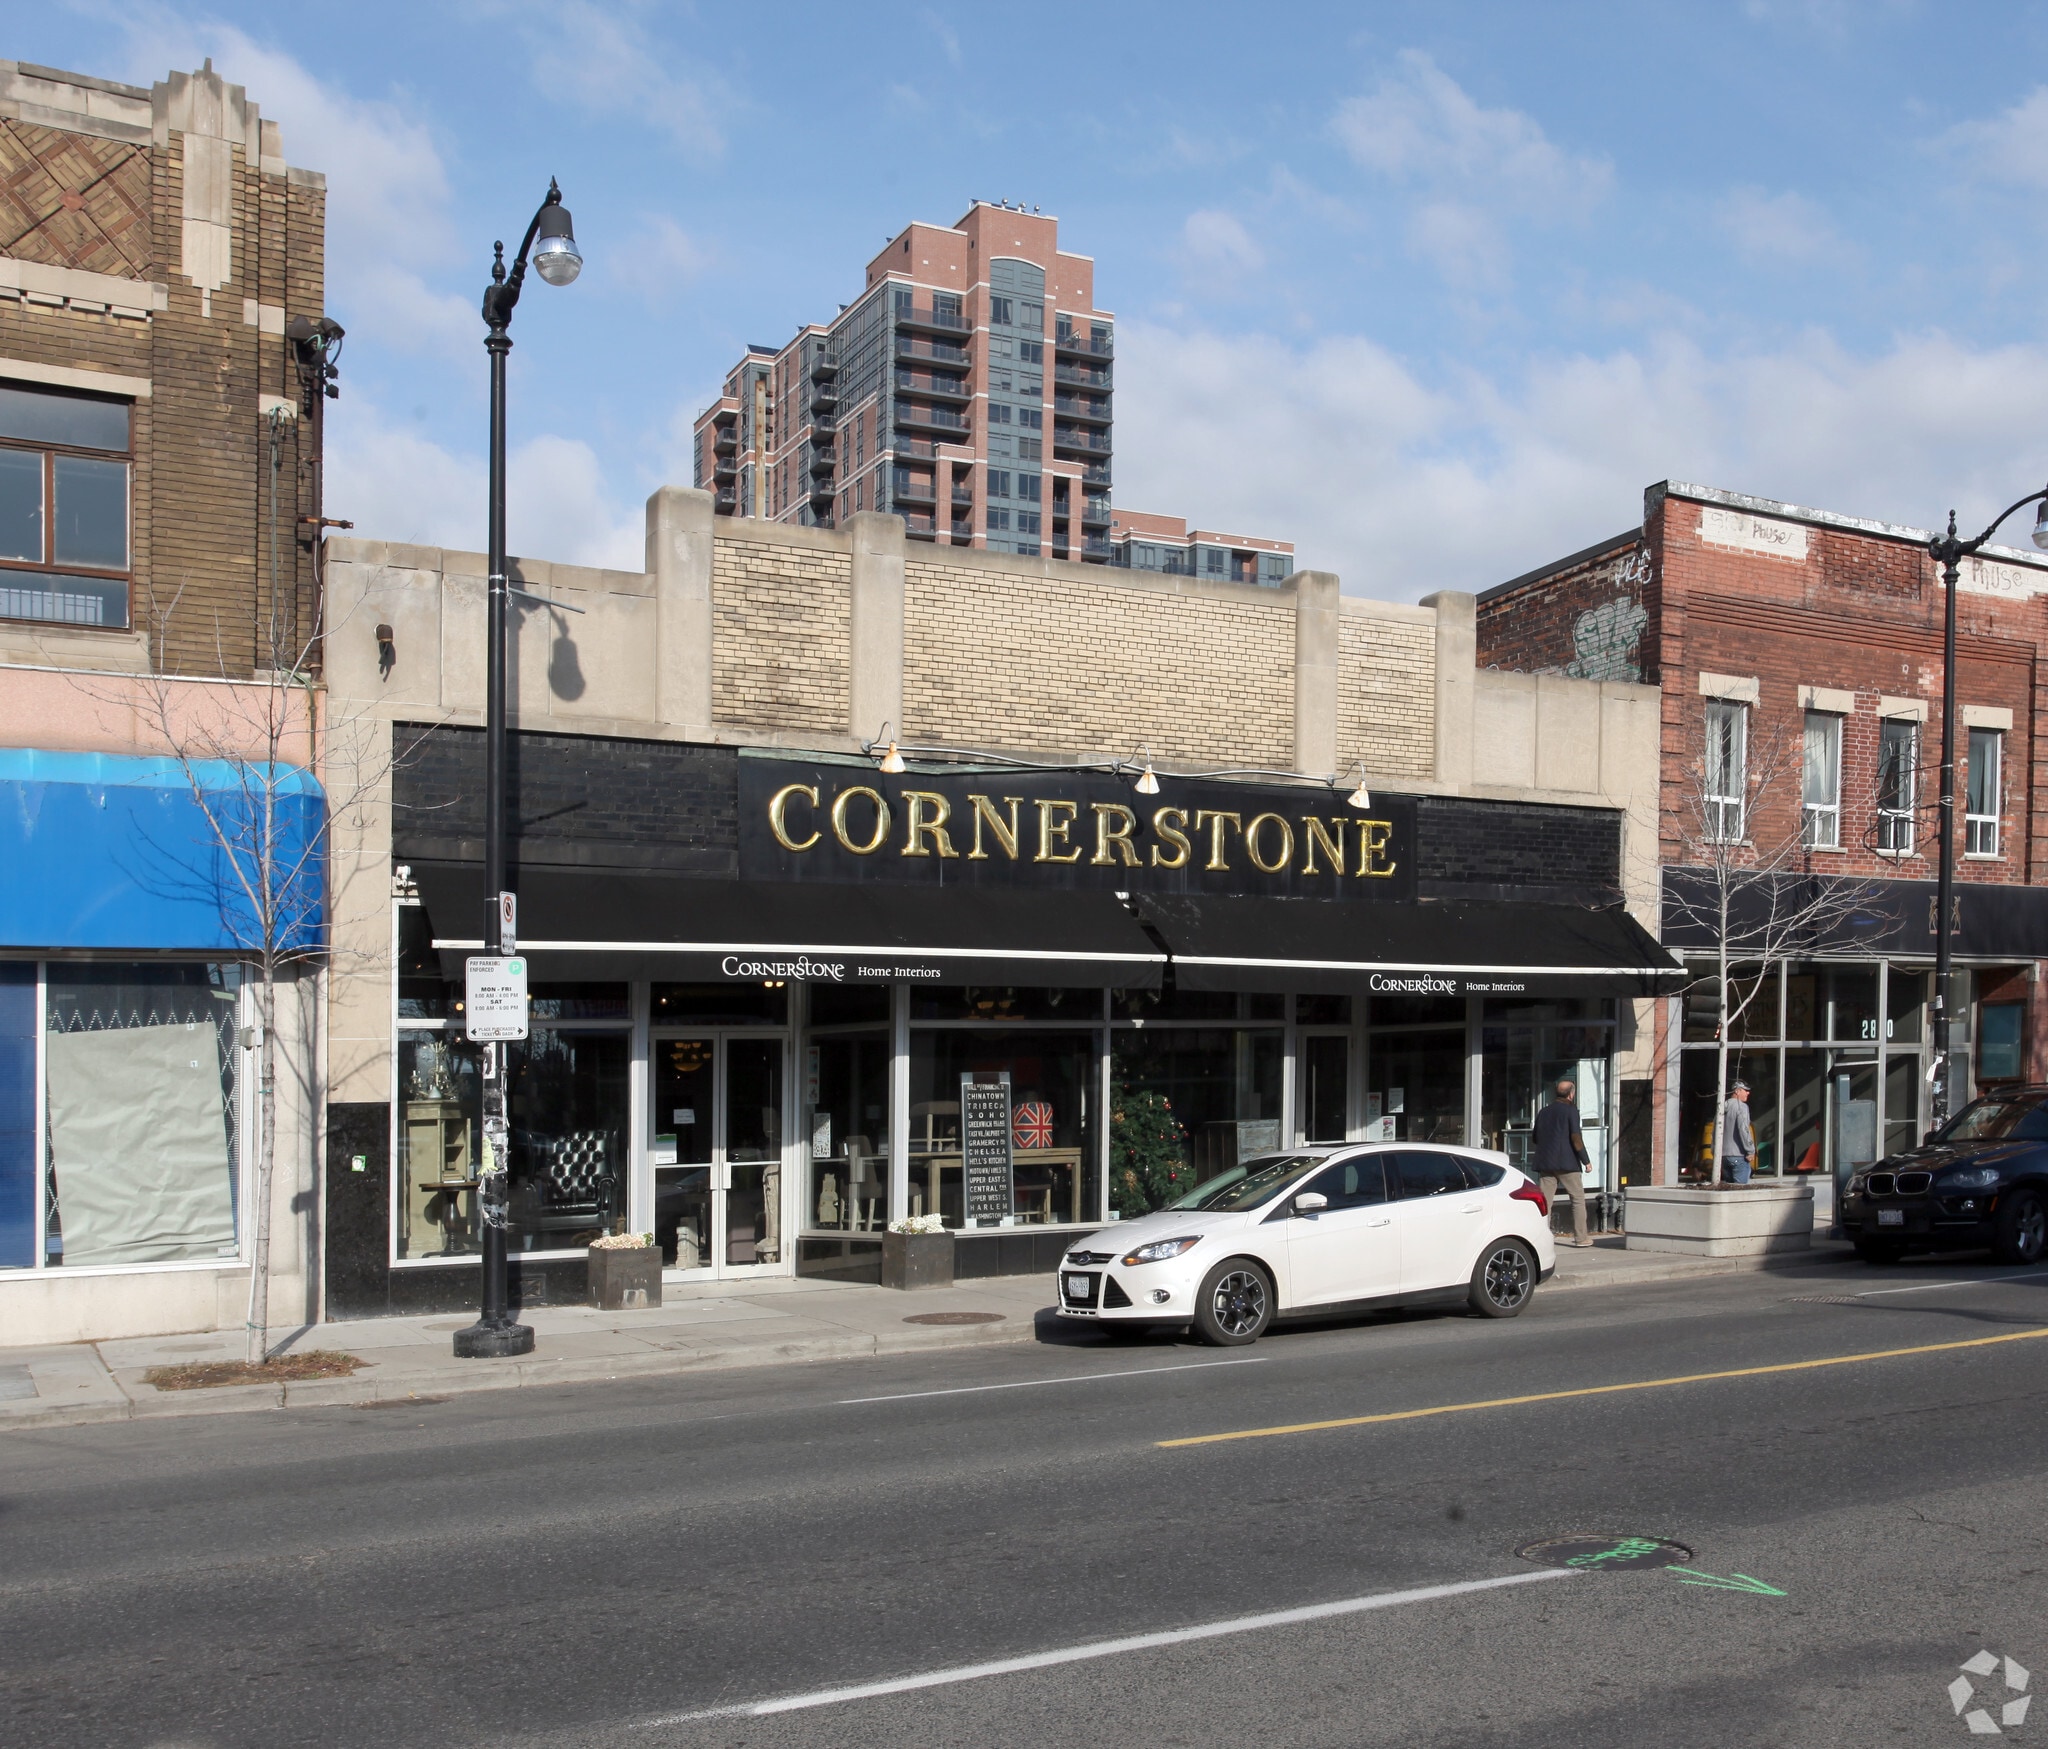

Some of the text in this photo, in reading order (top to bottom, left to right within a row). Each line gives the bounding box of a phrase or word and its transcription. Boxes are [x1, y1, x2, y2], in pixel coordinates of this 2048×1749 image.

[768, 783, 1397, 879] CORNERSTONE
[857, 966, 892, 977] Home
[894, 965, 941, 978] Interiors
[1465, 982, 1490, 991] Home
[1491, 980, 1525, 991] Interiors
[967, 1092, 1005, 1100] CHINATOWN
[967, 1102, 1005, 1110] TRIBECA
[967, 1111, 1005, 1119] SOHO
[968, 1148, 1006, 1156] CHELSEA
[969, 1157, 987, 1165] HELL'S
[969, 1185, 998, 1193] CENTRAL
[970, 1202, 1008, 1211] HARLEM
